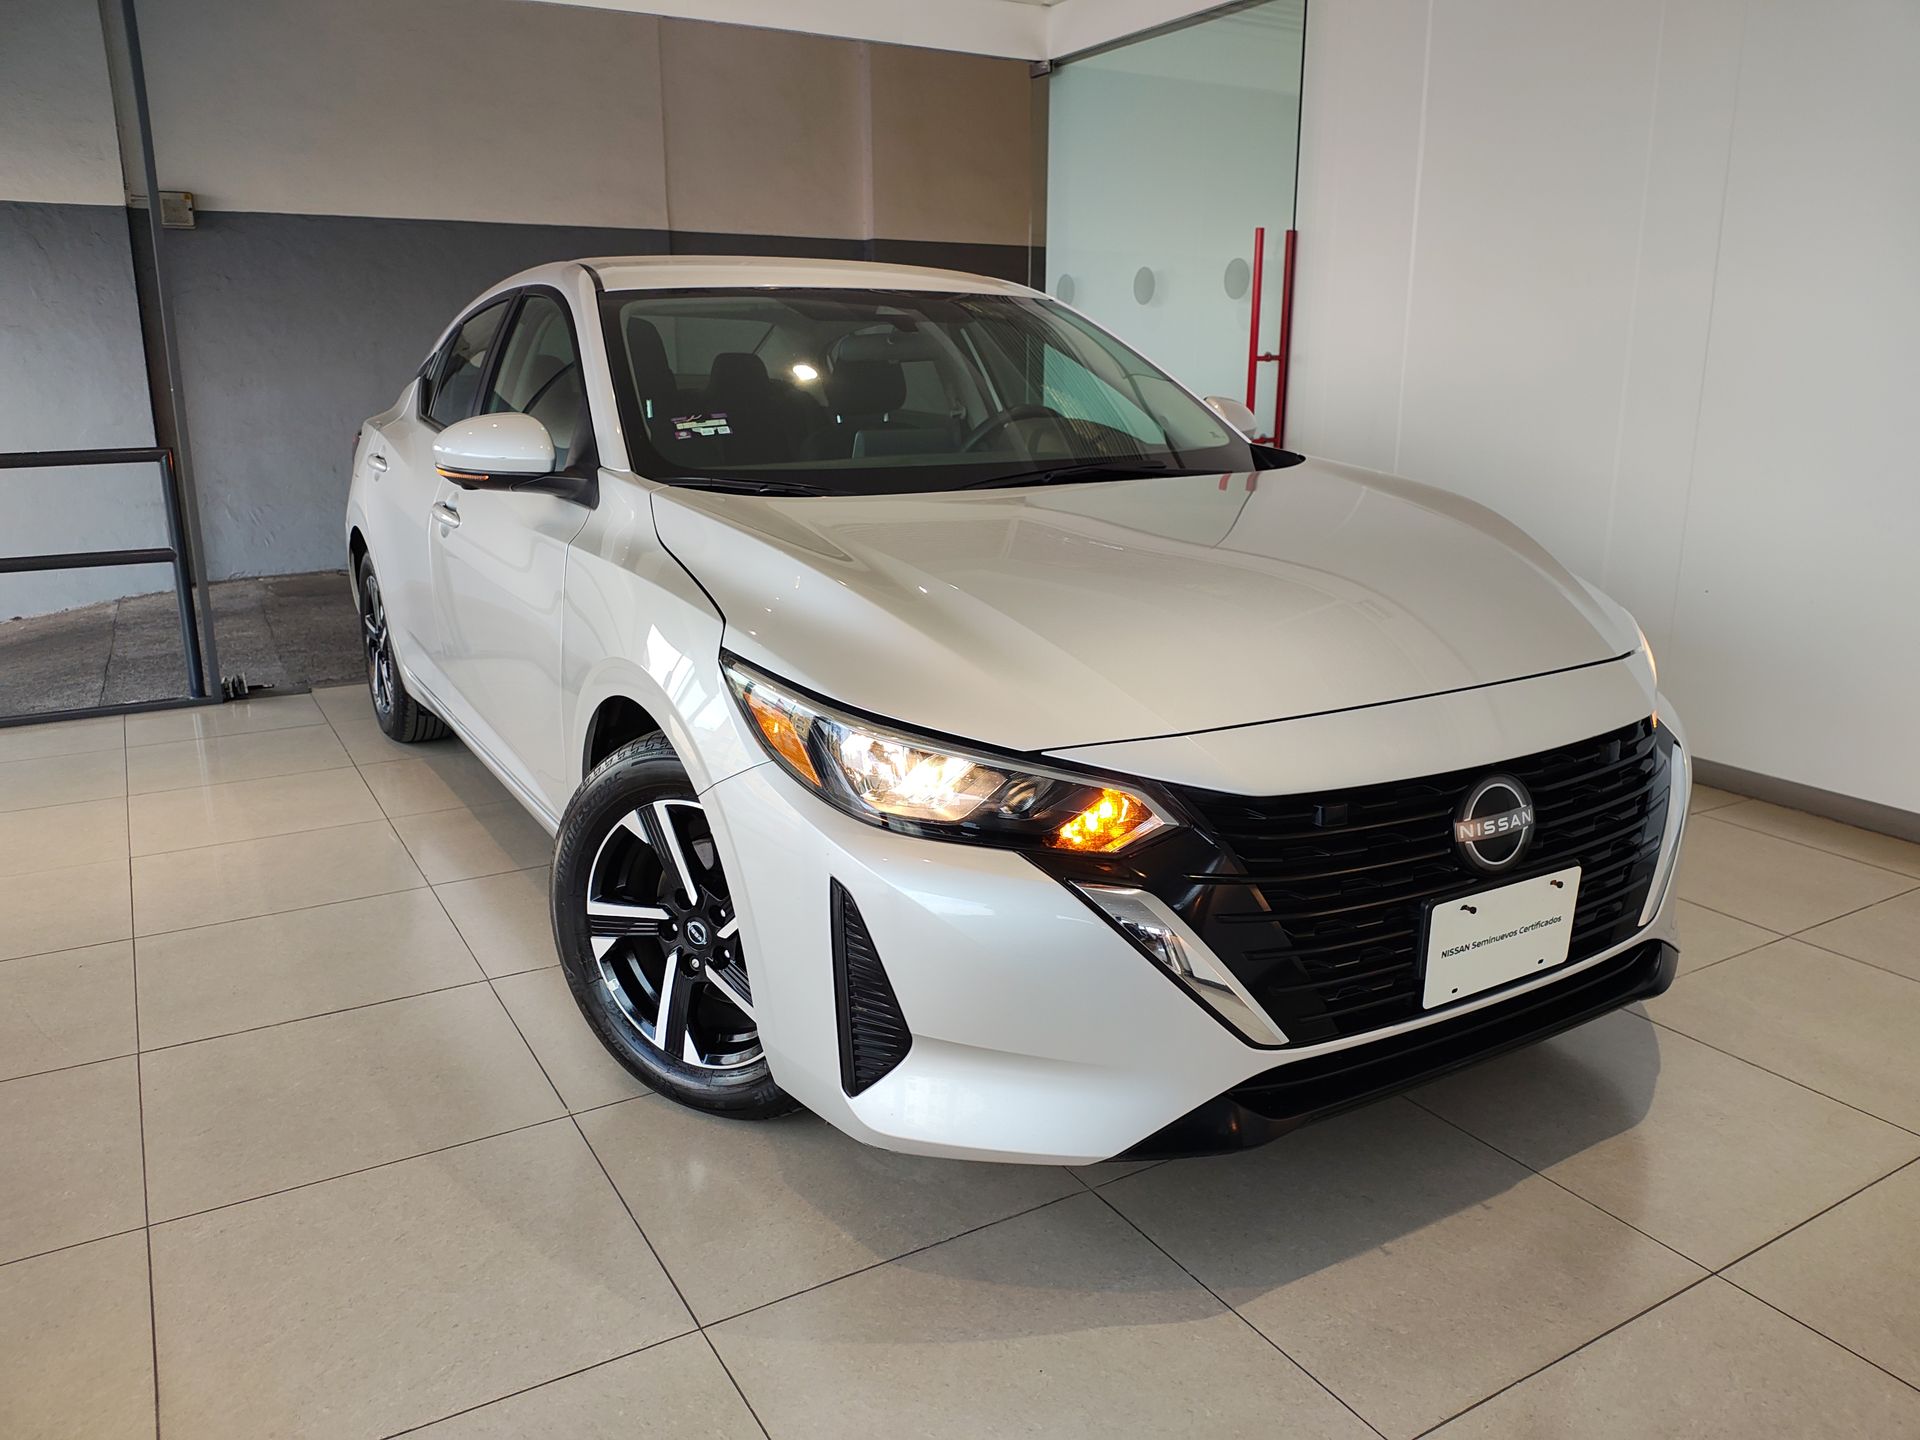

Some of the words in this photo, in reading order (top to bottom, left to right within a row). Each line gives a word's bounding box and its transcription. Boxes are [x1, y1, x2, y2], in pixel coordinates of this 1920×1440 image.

[1459, 809, 1531, 839] NISSAN
[1441, 943, 1471, 959] NISSAN
[1471, 929, 1518, 949] Seminuevos
[1518, 915, 1562, 934] Certificados
